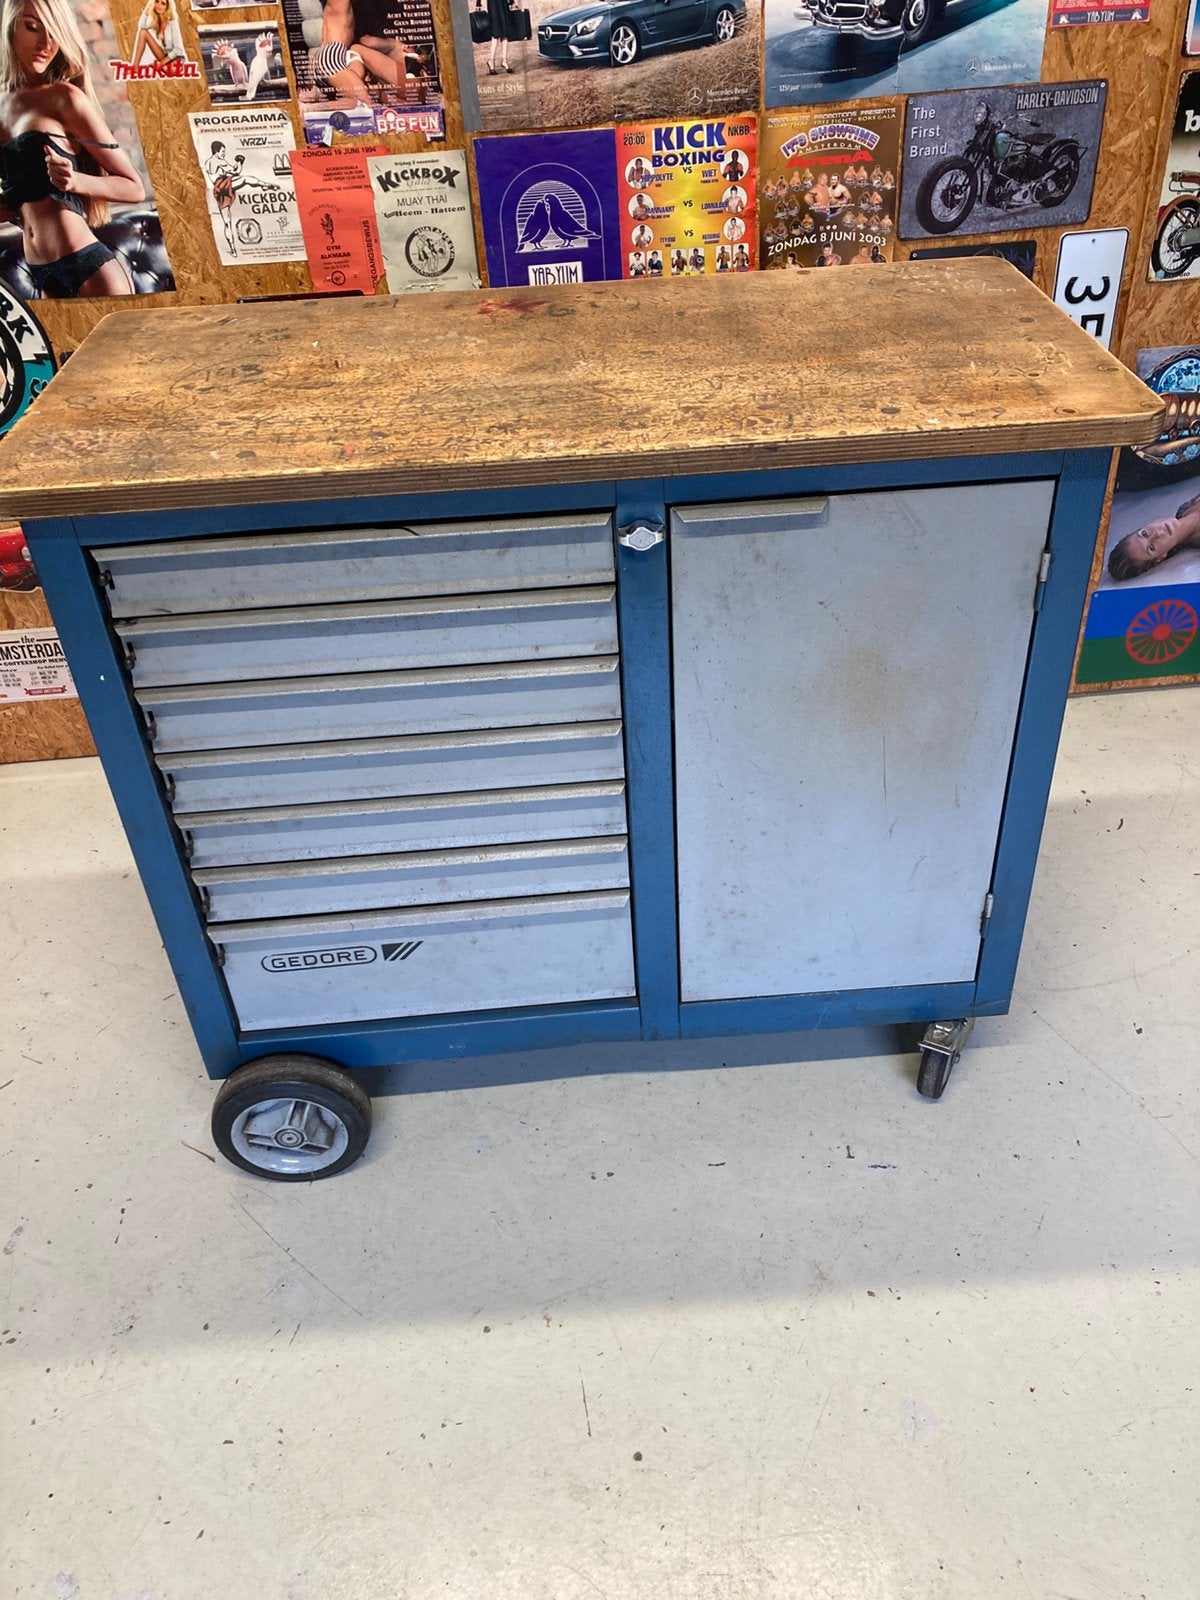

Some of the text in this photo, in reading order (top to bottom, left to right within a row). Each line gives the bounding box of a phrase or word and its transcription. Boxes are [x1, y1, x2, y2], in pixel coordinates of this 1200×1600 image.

[1016, 87, 1099, 110] HARLEY-DAVIDSON
[194, 113, 287, 127] PROGRAMMA
[913, 107, 936, 120] The
[409, 116, 439, 131] FUN
[654, 122, 727, 151] KICK
[911, 125, 941, 139] First
[624, 135, 645, 146] 20:00
[302, 149, 332, 158] ZONDAG
[344, 147, 360, 155] JUNI
[798, 142, 861, 155] AMSTERDAM
[910, 143, 949, 158] Brand
[652, 150, 725, 168] BOXING
[376, 165, 461, 193] KICKBOX
[238, 191, 296, 205] KICKBOX
[397, 195, 448, 207] MUAY THAI
[251, 203, 288, 215] GALA
[431, 206, 466, 214] Hattem
[768, 231, 887, 256] ZONDAG 8 JUNI 2003
[21, 635, 35, 644] the
[0, 642, 64, 661] MSTERDA
[271, 949, 367, 969] GEDORE
